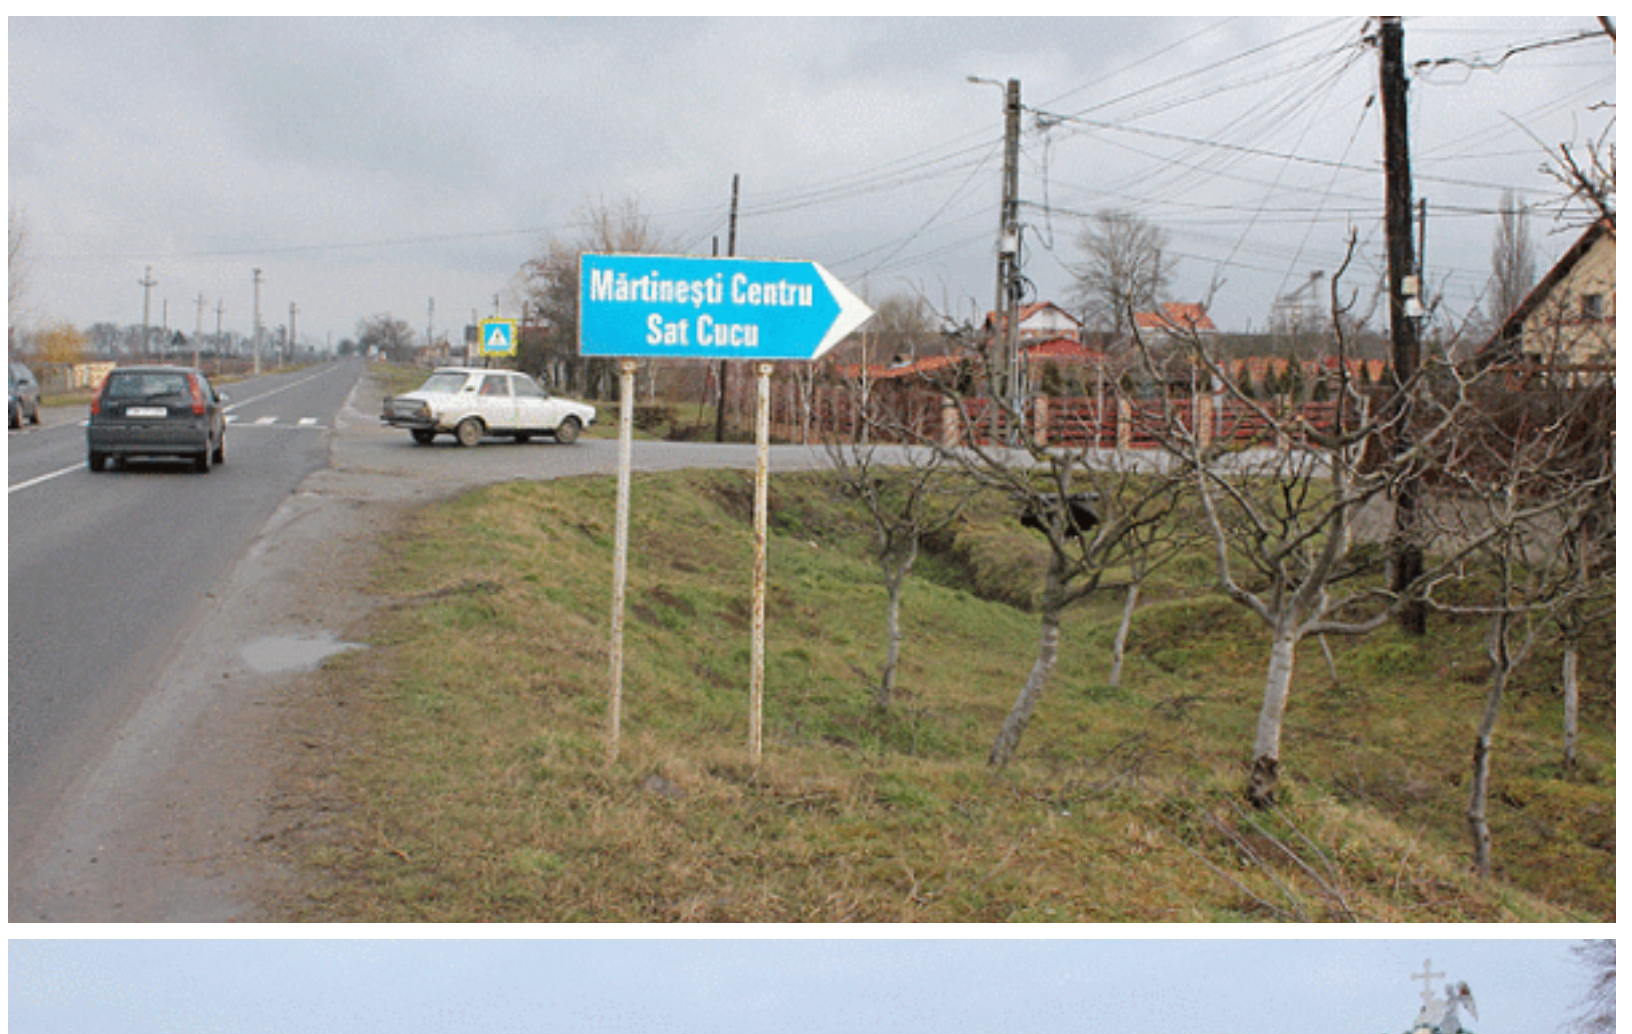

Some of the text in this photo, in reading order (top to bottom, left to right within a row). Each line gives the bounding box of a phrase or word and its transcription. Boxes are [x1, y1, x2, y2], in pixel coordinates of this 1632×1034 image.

[730, 272, 813, 306] Centru
[646, 314, 759, 347] Sat Cucu
